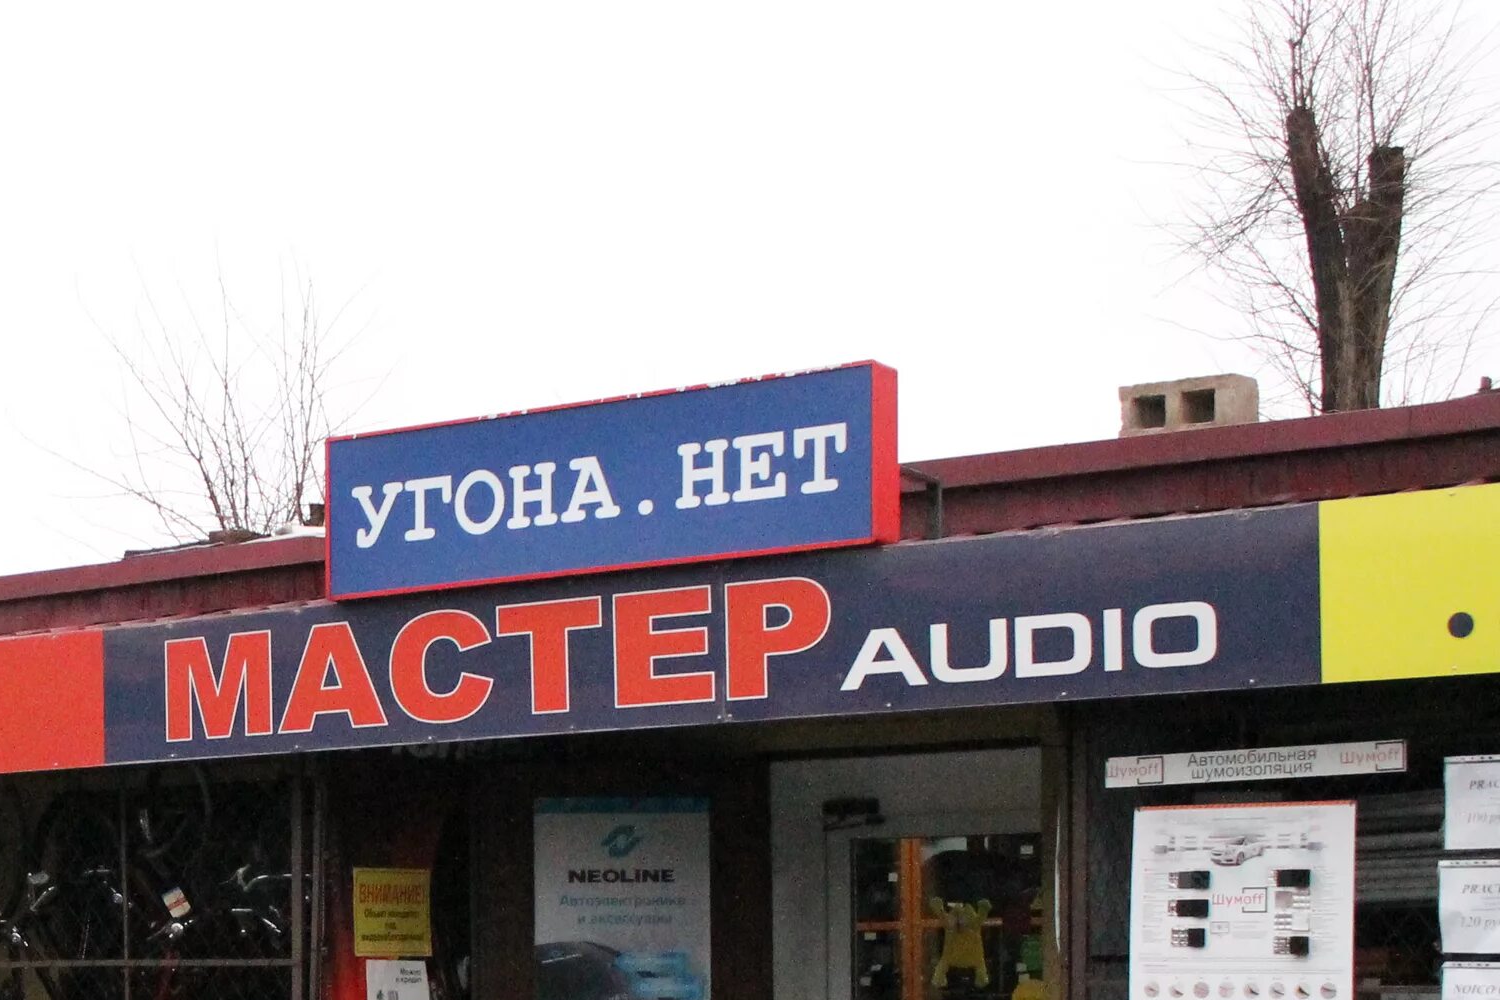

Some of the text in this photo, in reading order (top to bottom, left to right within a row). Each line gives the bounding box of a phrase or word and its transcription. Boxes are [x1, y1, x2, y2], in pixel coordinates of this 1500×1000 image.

[164, 576, 1217, 744] МАСТЕР AUDIO
[1187, 748, 1318, 767] Автомобильная
[1191, 762, 1313, 783] шумоизоляция
[568, 869, 675, 883] NEOLINE
[1453, 984, 1495, 994] NOICO
